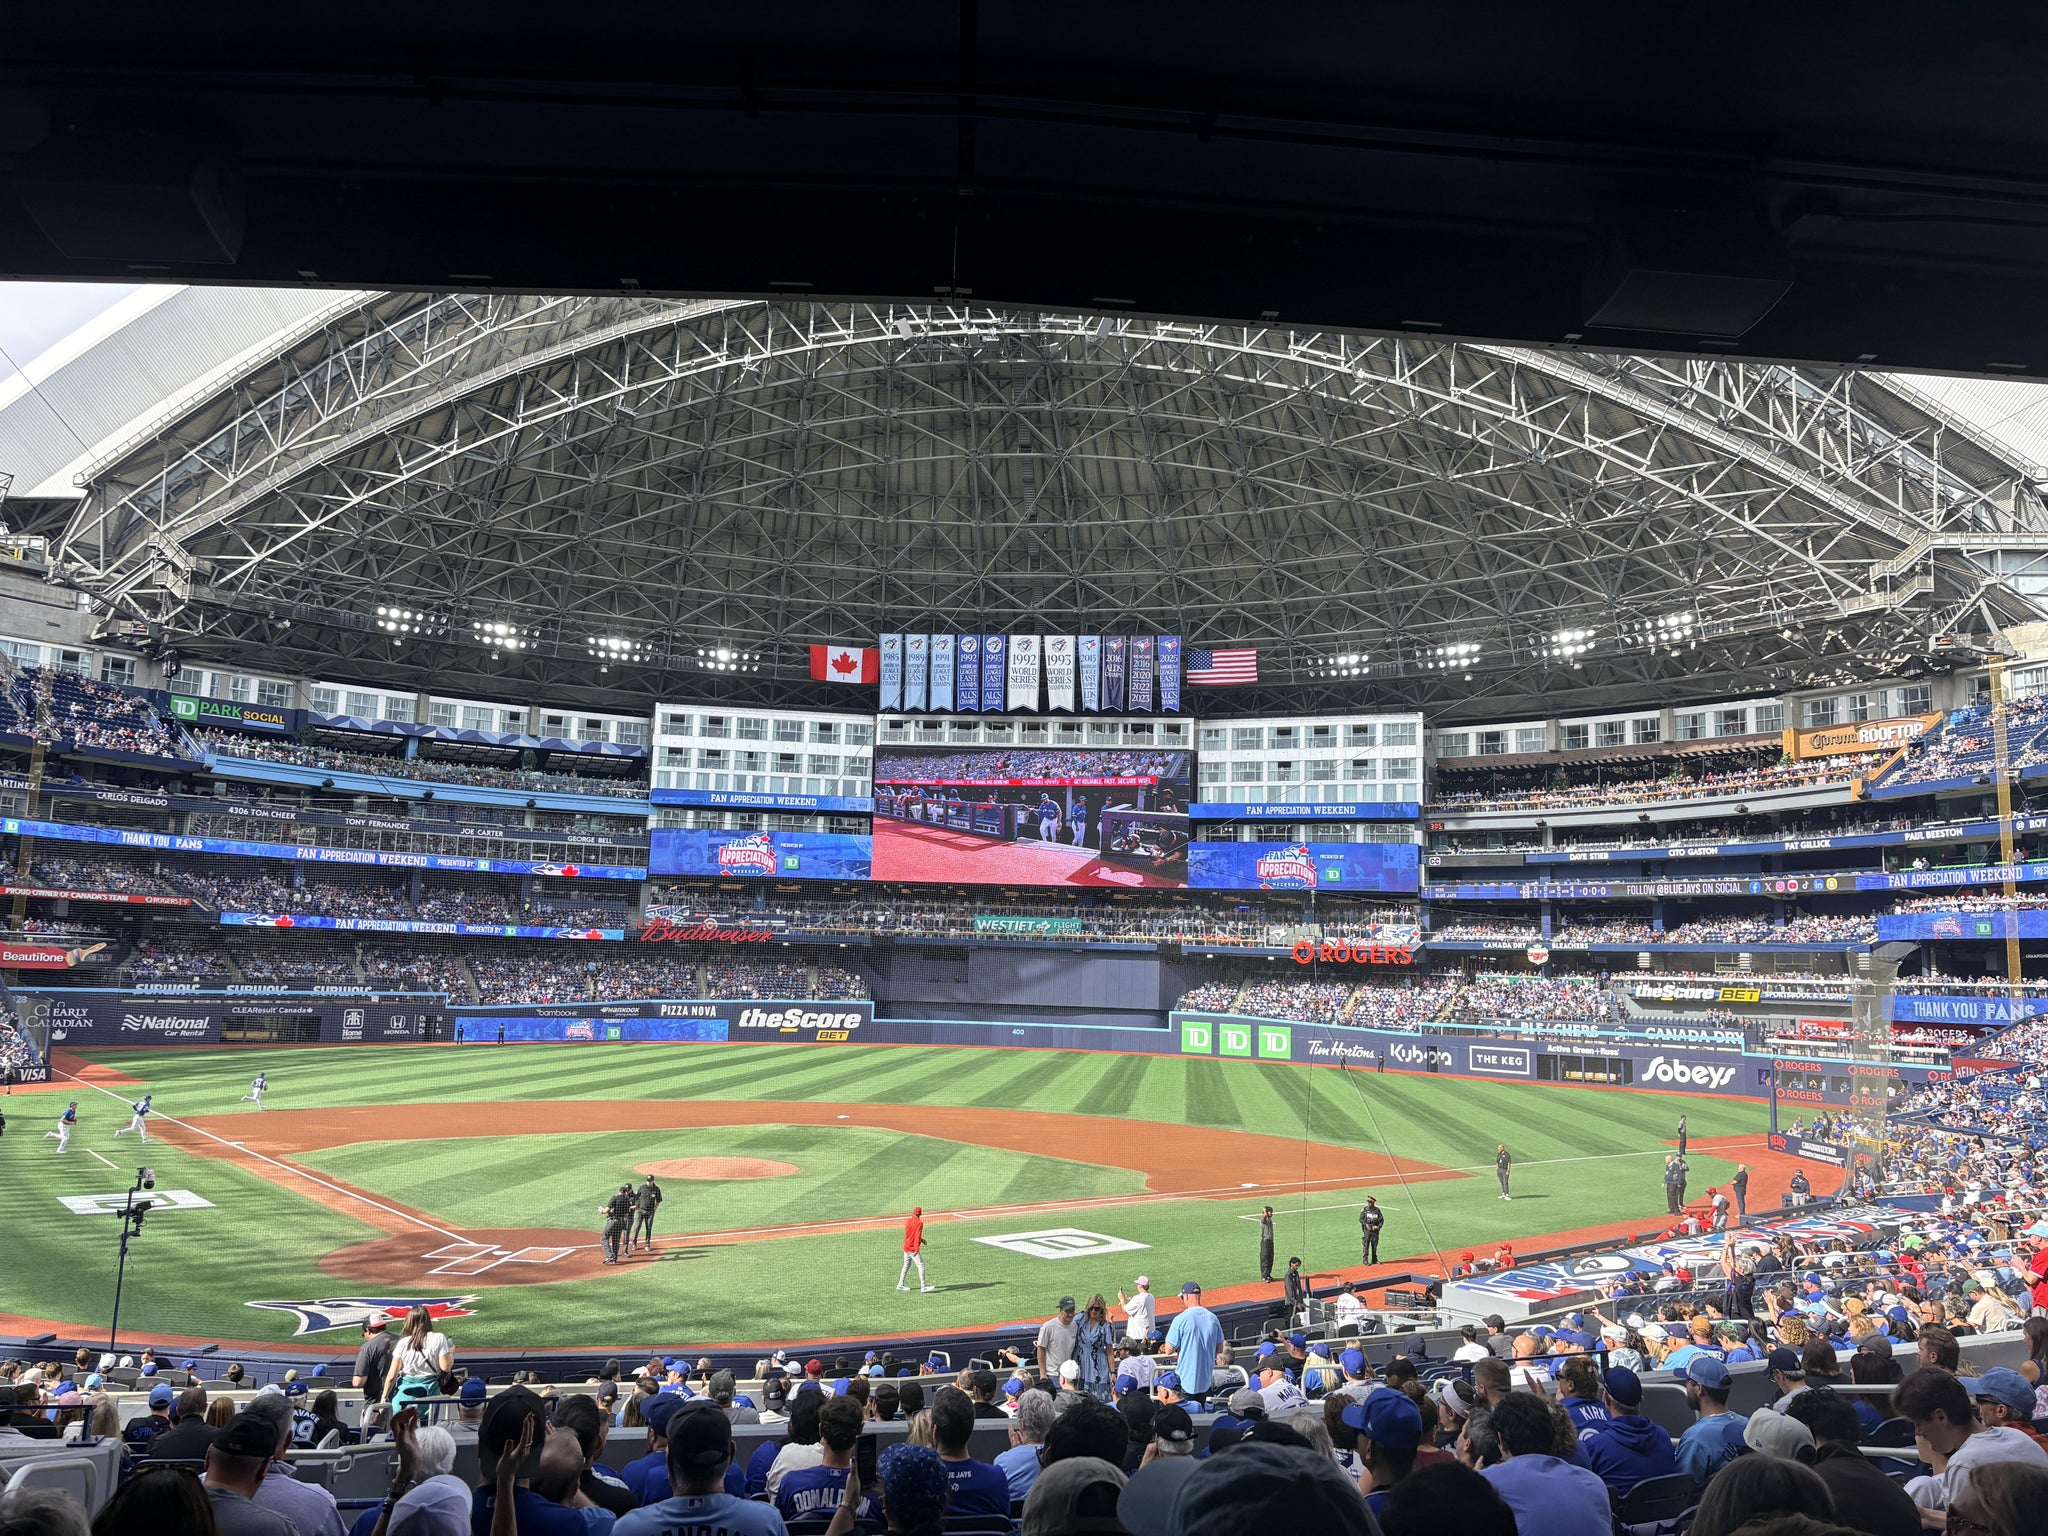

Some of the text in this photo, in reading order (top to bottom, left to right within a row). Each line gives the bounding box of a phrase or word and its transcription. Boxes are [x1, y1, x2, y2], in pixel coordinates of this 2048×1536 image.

[883, 653, 900, 661] 1985
[908, 653, 925, 661] 1989
[961, 654, 977, 662] 1992
[986, 654, 1002, 662] 1993
[1013, 654, 1036, 666] 1992
[1047, 654, 1072, 666] 1993
[1080, 654, 1097, 663] 2015
[1105, 654, 1123, 663] 2016
[1160, 654, 1178, 663] 2025
[1105, 663, 1123, 672] ALDS
[1133, 659, 1150, 668] 2016
[1011, 667, 1037, 675] WORLD
[1047, 668, 1072, 676] WORLD
[1132, 671, 1150, 679] 2020
[1010, 676, 1037, 684] SERIES
[1048, 676, 1072, 684] SERIES
[1131, 682, 1150, 691] 2022
[960, 691, 977, 699] ALCS
[985, 691, 1002, 699] ALCS
[1131, 693, 1150, 703] 2023
[173, 699, 285, 724] TD PARK SOCIAL
[1809, 723, 1924, 751] Corona ROOFTOP
[1877, 739, 1906, 749] PATIO
[96, 792, 168, 807] CARLOS DELGADO
[710, 794, 818, 806] FAN APPRECIATION WEEKEND
[228, 806, 296, 820] 4306 TOM CHEEK
[1246, 806, 1356, 815] FAN APPRECIATION WEEKEND
[345, 818, 410, 830] TONY FERNANDEZ
[2029, 818, 2047, 829] ROY
[460, 828, 504, 838] JOE CARTER
[1904, 827, 1963, 841] PAUL BEESTON
[122, 832, 203, 850] THANK YOU FANS
[567, 835, 595, 843] GEORGE
[731, 839, 748, 848] FAN
[1784, 839, 1831, 850] PAT GILLICK
[297, 848, 427, 866] FAN APPRECIATION WEEKEND
[1269, 851, 1286, 860] FAN
[1569, 852, 1609, 861] DAVE STIEB
[1668, 847, 1718, 857] CITO GASTON
[437, 858, 489, 870] PRESENTED TD
[721, 850, 774, 870] APPRECIATION
[786, 858, 798, 867] TD
[1259, 860, 1314, 881] APPRECIATION
[1326, 870, 1339, 879] TD
[1888, 867, 2023, 887] FAN APPRECIATION WEEKEND
[5, 887, 31, 896] PROUD
[32, 889, 58, 897] OWNER
[59, 890, 69, 898] OF
[1626, 882, 1742, 896] FOLLOW @BLUEJAYS ON SOCIAL
[152, 897, 179, 905] ROGERS
[335, 918, 456, 934] FAN APPRECIATION WEEKEND
[466, 925, 515, 935] PRESENTED TD
[637, 914, 774, 943] Budweiser
[1978, 923, 1990, 933] TD
[3, 952, 64, 963] BeautiTone
[1320, 944, 1413, 965] ROGERS
[1635, 985, 1716, 1000] theScore
[1721, 989, 1759, 1001] BET
[1765, 991, 1811, 999] SPORTSBOOK
[1819, 992, 1848, 1000] CASINO
[34, 1001, 89, 1019] CLEARLY
[539, 1009, 578, 1017] bambooHR
[660, 1004, 717, 1018] PIZZA NOVA
[1913, 1001, 2036, 1021] THANK YOU FANS
[25, 1015, 94, 1028] CANADIAN
[141, 1016, 208, 1029] National
[738, 1008, 862, 1028] theScore
[610, 1029, 619, 1037] TD
[819, 1031, 847, 1039] BET
[1011, 1028, 1025, 1036] 400
[1184, 1027, 1209, 1047] TD
[1927, 1029, 1968, 1039] ROGERS
[1222, 1029, 1248, 1050] TD
[1261, 1031, 1288, 1052] TD
[1308, 1040, 1375, 1059] Tim Hortons
[1547, 1044, 1571, 1053] Active
[1390, 1043, 1452, 1066] Kubota
[1476, 1054, 1523, 1066] THE KEG
[1641, 1055, 1736, 1089] Sobeys
[1785, 1061, 1822, 1072] ROGERS
[1859, 1066, 1900, 1078] ROGERS
[18, 1068, 46, 1081] VISA
[1786, 1089, 1824, 1101] ROGERS
[1769, 1135, 1787, 1150] HEINZ
[293, 1410, 320, 1424] AVAGE
[1579, 1405, 1608, 1422] KIRK
[955, 1470, 972, 1478] JAYS
[793, 1488, 871, 1517] DONALDN
